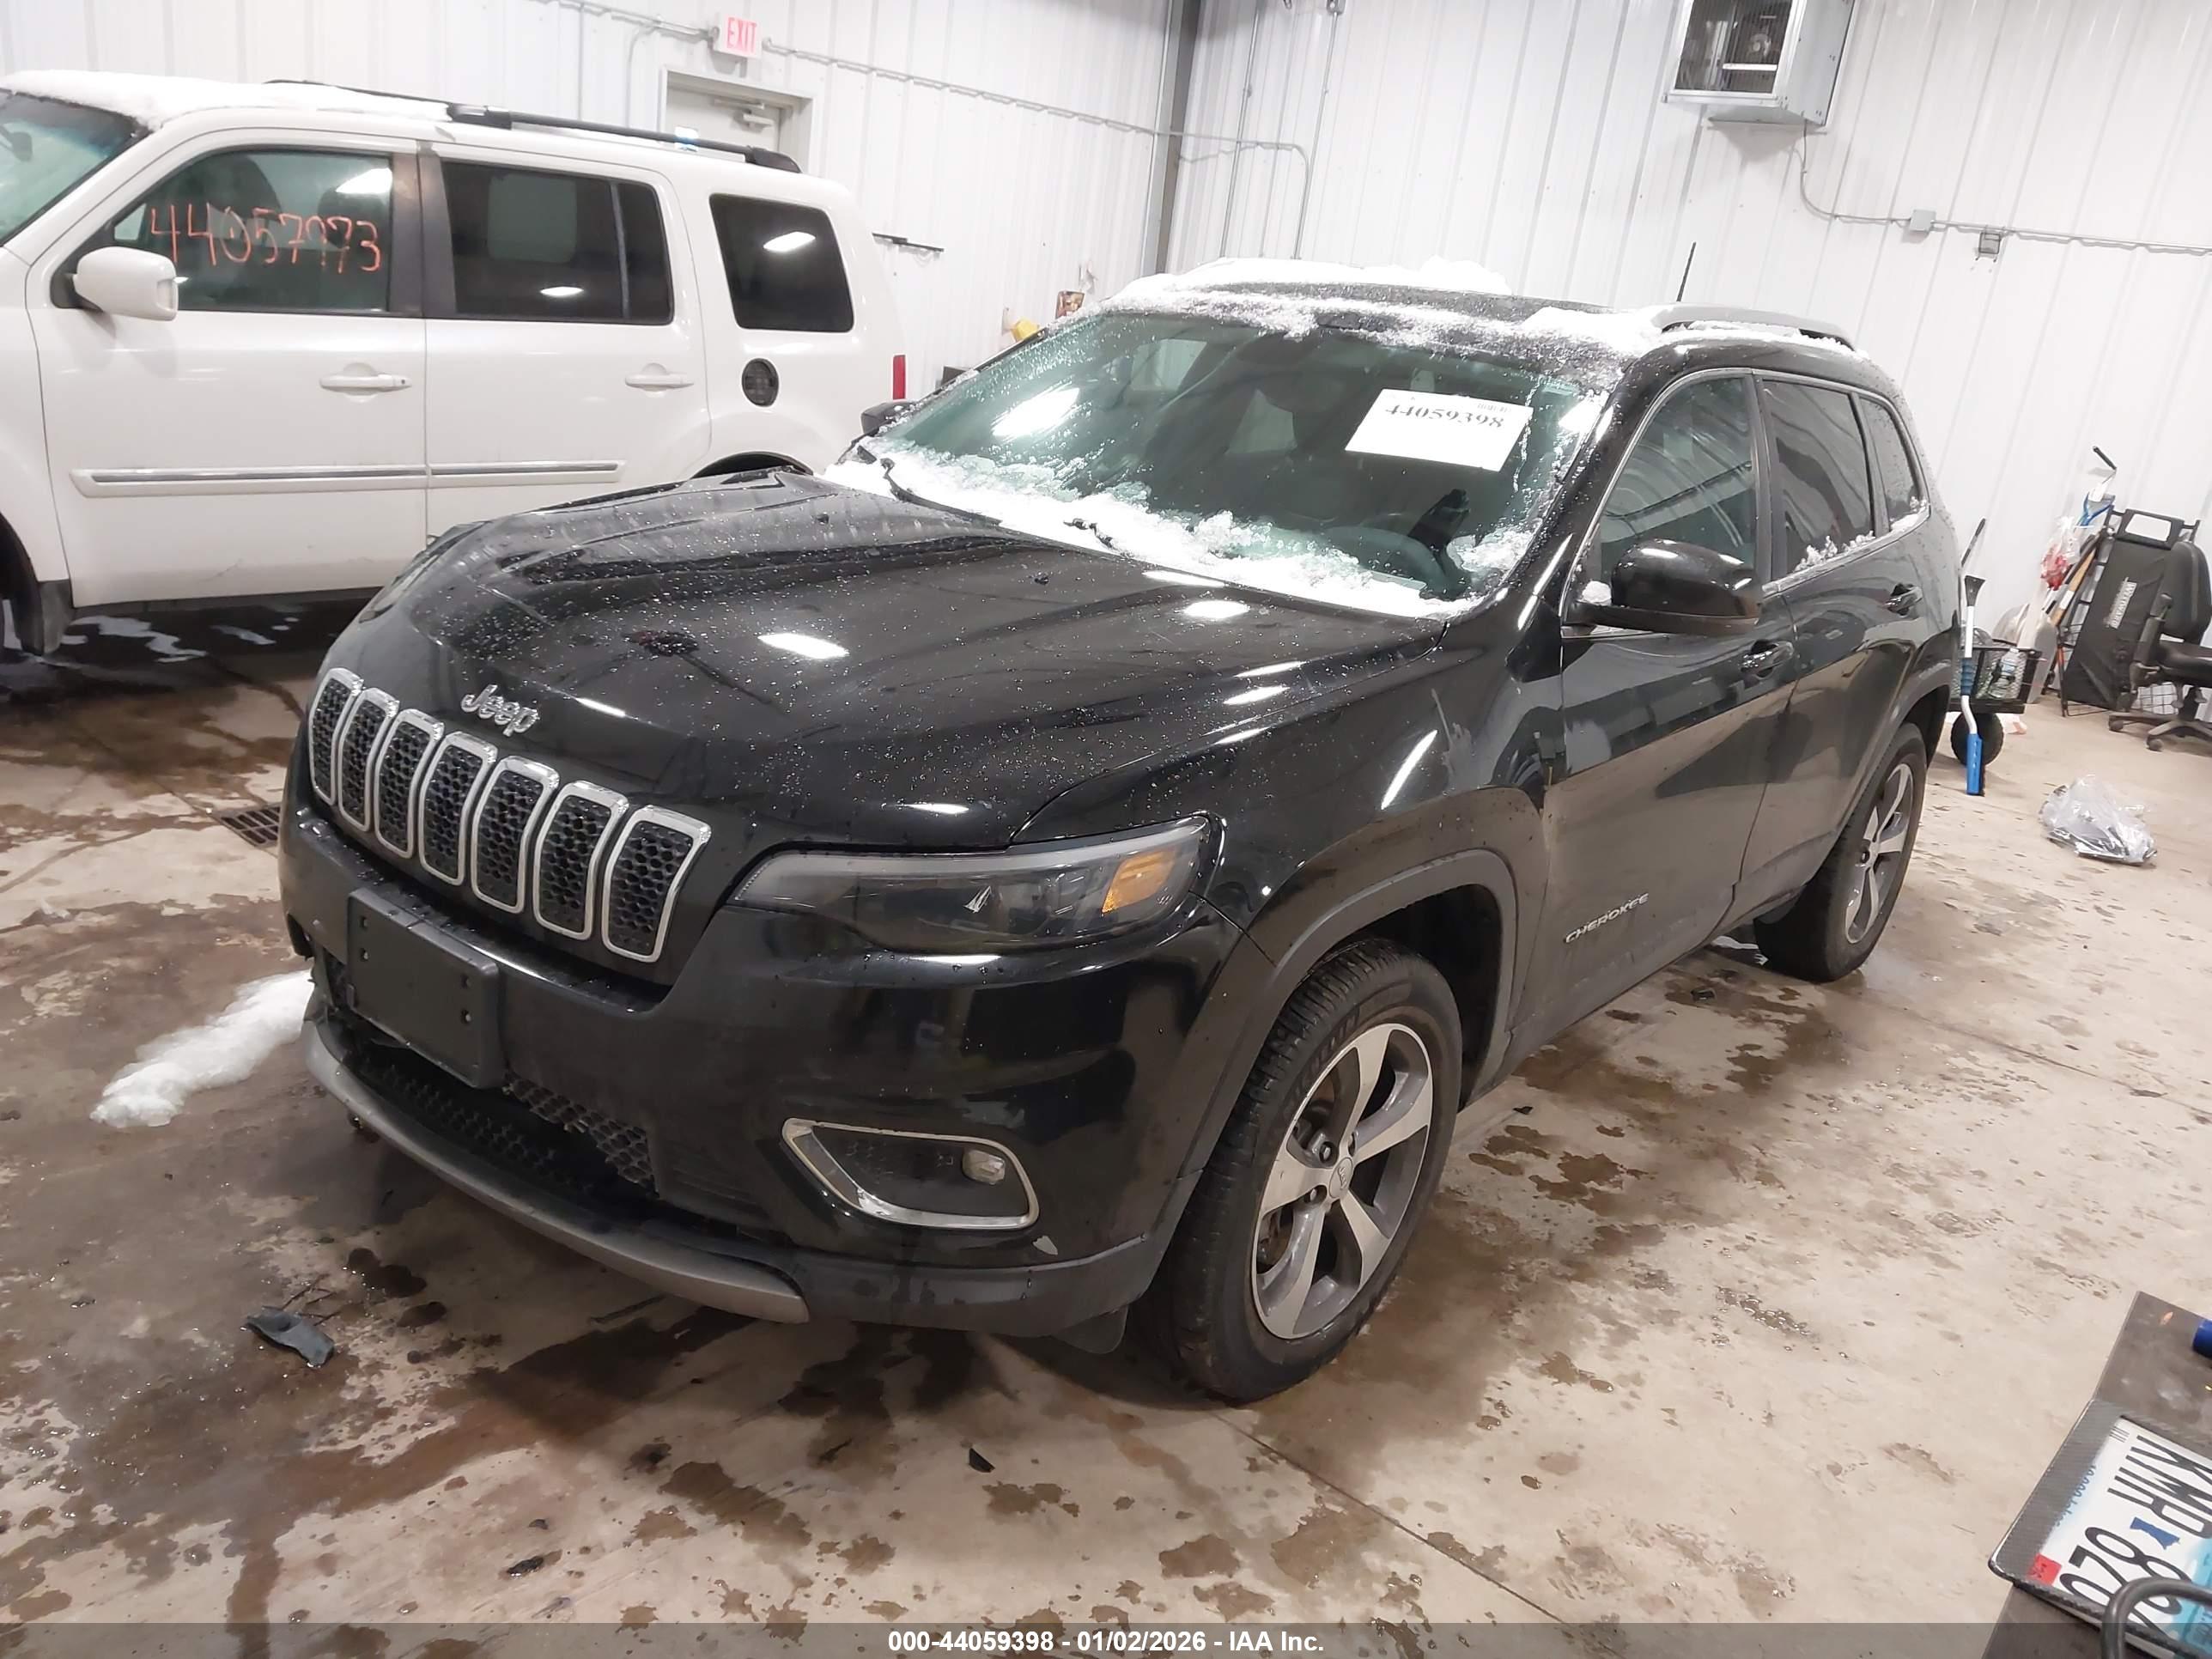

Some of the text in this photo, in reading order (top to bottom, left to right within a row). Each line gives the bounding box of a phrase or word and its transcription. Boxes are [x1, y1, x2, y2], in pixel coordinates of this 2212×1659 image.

[727, 16, 757, 53] EXIT
[150, 201, 381, 274] 44057973
[1385, 404, 1504, 428] 44059398
[461, 684, 540, 737] Jeep
[1565, 893, 1649, 943] CHEROKEE
